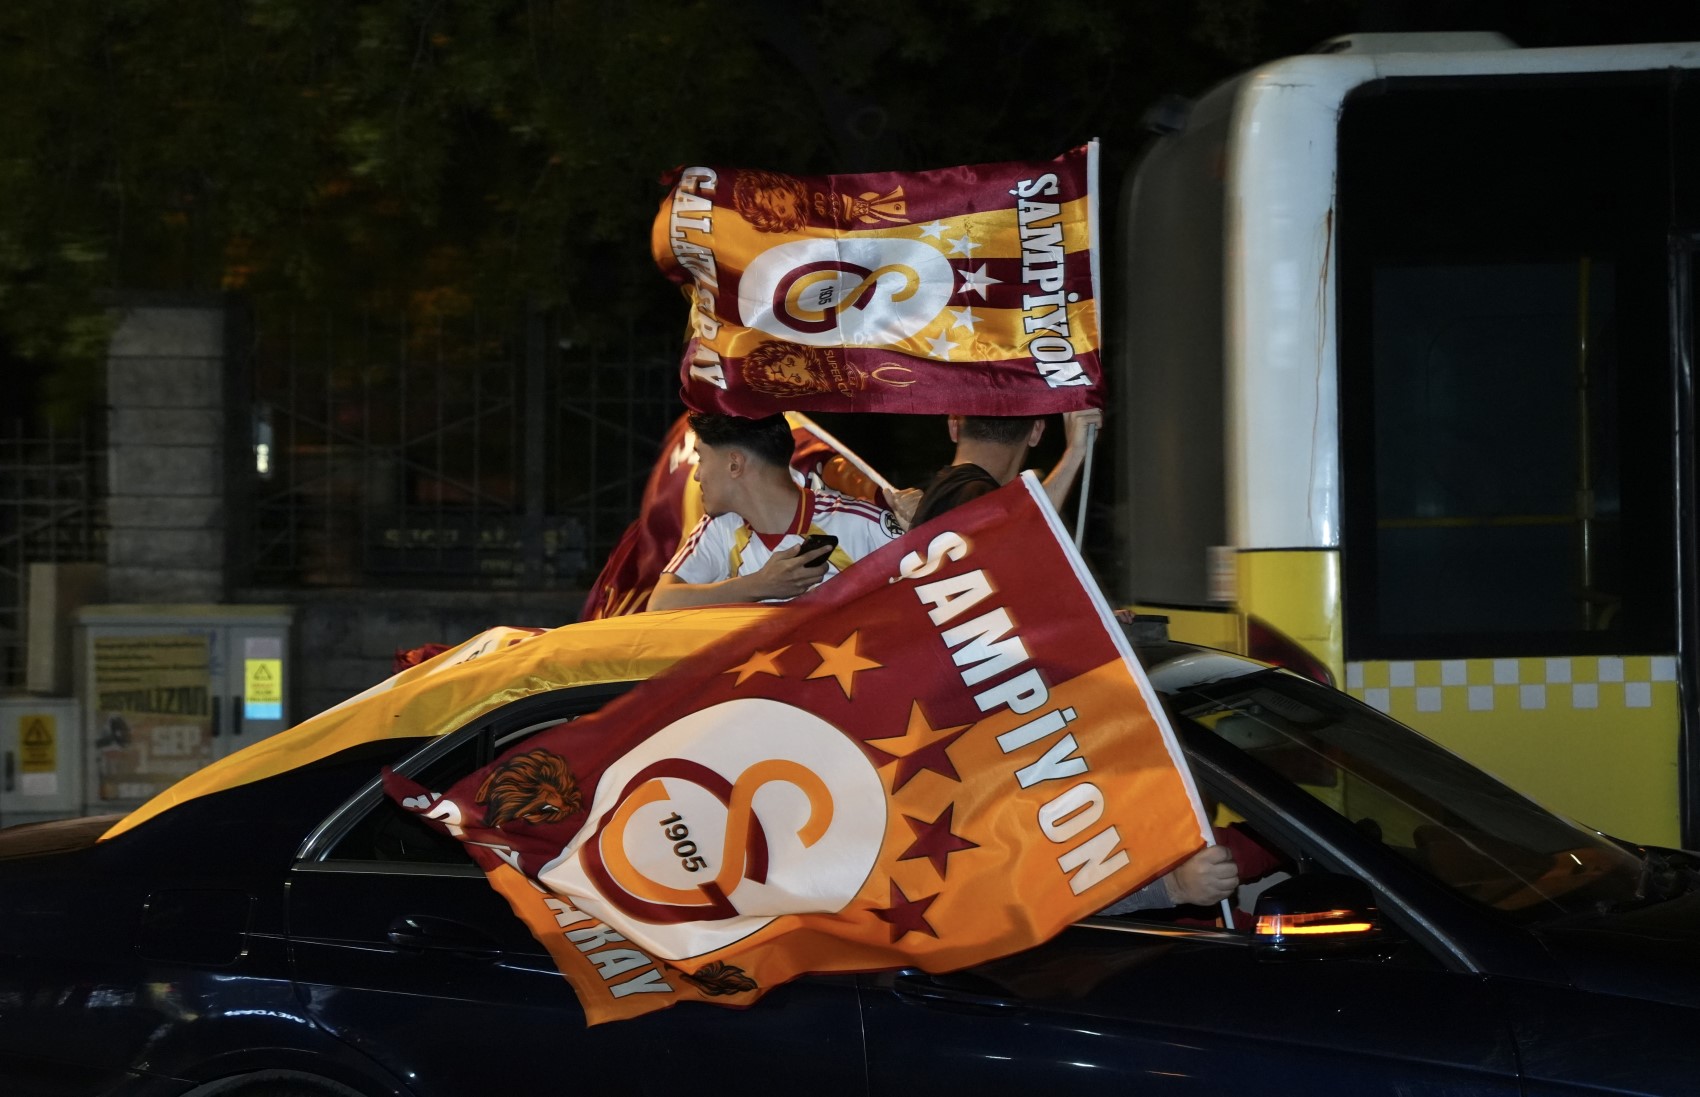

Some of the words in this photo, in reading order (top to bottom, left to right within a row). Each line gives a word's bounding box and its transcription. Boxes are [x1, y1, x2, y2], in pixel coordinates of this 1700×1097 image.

[818, 285, 834, 308] 1905
[1009, 173, 1093, 388] ŞAMPİYON
[823, 349, 843, 383] SUPER
[888, 531, 1131, 896] ŞAMPİYON
[658, 811, 708, 873] 1905
